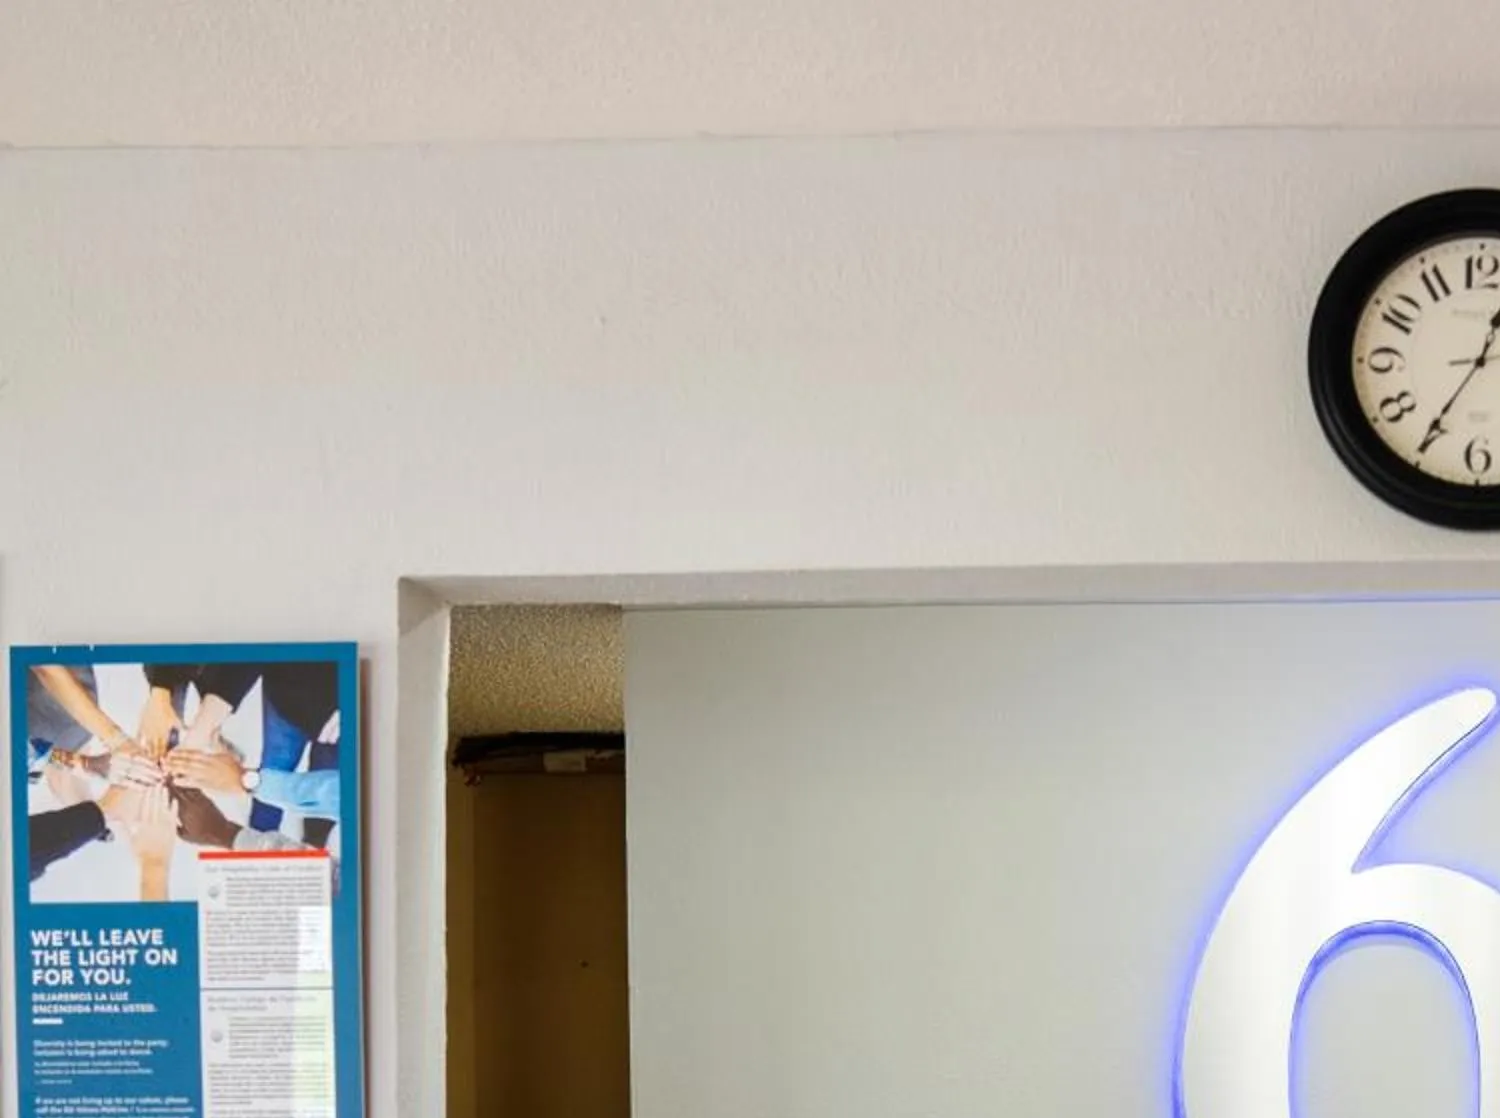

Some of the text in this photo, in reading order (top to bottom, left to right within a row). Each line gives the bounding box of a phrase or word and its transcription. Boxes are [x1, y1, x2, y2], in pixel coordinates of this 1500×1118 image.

[1420, 264, 1452, 301] 11
[1465, 254, 1500, 290] 12
[1381, 294, 1422, 336] 10
[1368, 346, 1405, 374] 9
[1379, 389, 1417, 424] 8
[1464, 438, 1492, 474] 6
[30, 928, 164, 947] WE'LL LEAVE
[31, 949, 178, 966] THE LIGHT ON
[32, 968, 132, 986] FOR YOU.
